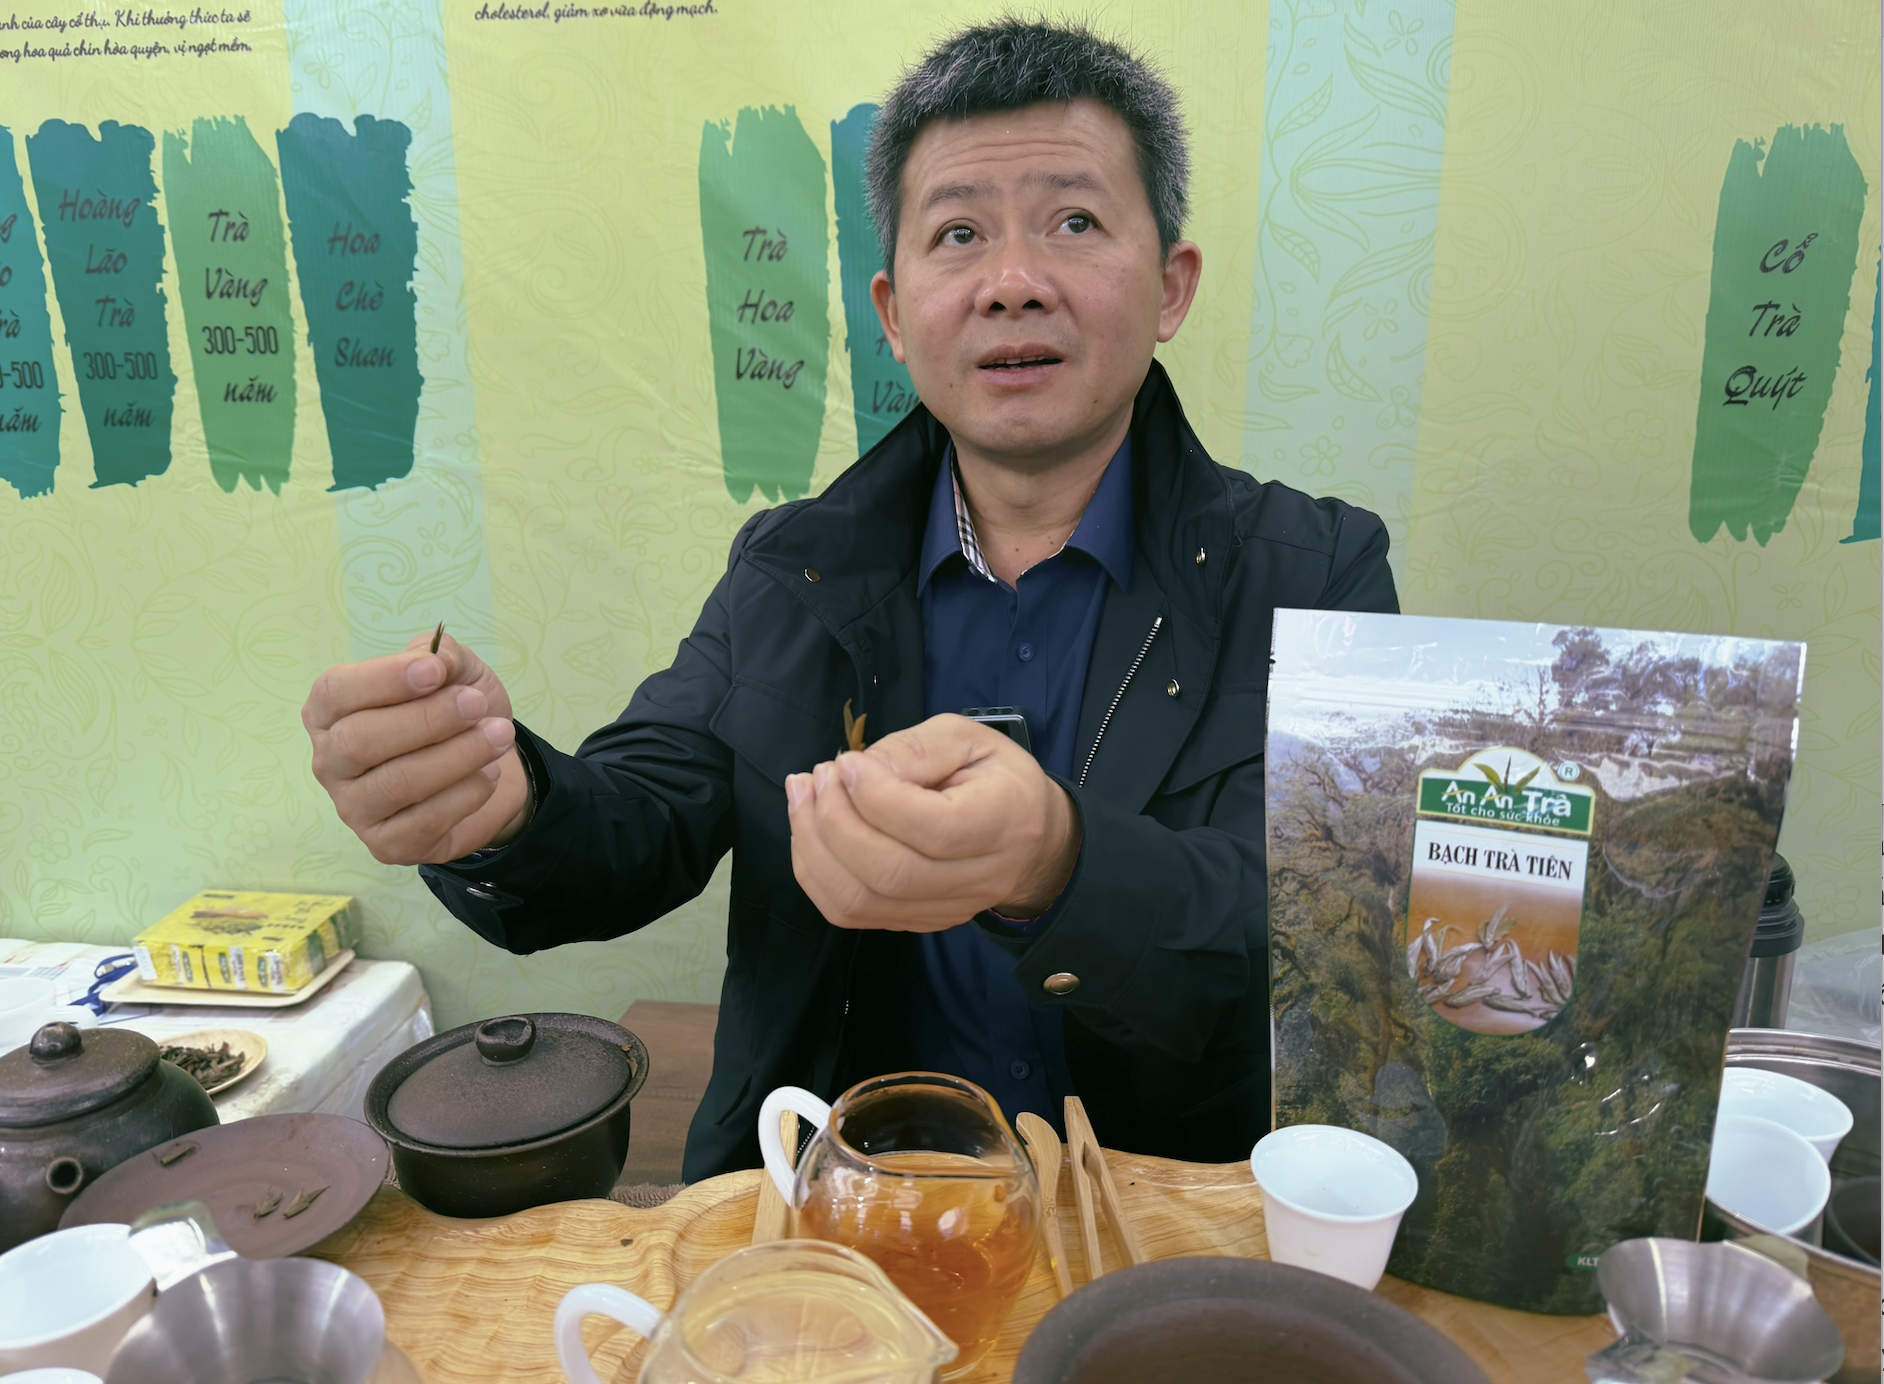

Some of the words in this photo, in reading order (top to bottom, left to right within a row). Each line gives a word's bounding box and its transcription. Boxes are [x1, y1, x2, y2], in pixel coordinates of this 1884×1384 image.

[21, 16, 43, 30] của
[45, 16, 67, 33] cây
[68, 12, 84, 28] cổ
[115, 9, 141, 27] Khi
[220, 8, 236, 24] ta
[236, 9, 251, 23] sẽ
[553, 3, 590, 24] giảm
[639, 0, 674, 21] động
[676, 0, 718, 18] mạch.
[23, 41, 47, 58] hoa
[48, 42, 72, 61] quả
[73, 38, 102, 57] chín
[104, 38, 128, 55] hòa
[173, 40, 187, 57] vị
[188, 38, 217, 58] ngọt
[58, 188, 141, 229] Hoàng
[208, 208, 250, 243] Trà
[328, 222, 381, 257] Hoa
[742, 226, 788, 263] Trà
[1759, 232, 1818, 275] Cổ
[85, 244, 128, 275] Lão
[204, 267, 268, 308] Vàng
[336, 281, 385, 312] Chè
[95, 294, 136, 329] Trà
[737, 288, 795, 324] Hoa
[1749, 300, 1801, 338] Trà
[202, 326, 279, 356] 300-500
[334, 337, 396, 368] Shan
[83, 352, 158, 381] 300-500
[735, 348, 804, 390] Vàng
[223, 376, 278, 404] năm
[1722, 365, 1808, 411] Quýt
[103, 402, 155, 428] năm
[1441, 780, 1476, 805] An
[1479, 785, 1514, 809] An
[1521, 790, 1572, 817] Trà
[1446, 802, 1466, 815] Tốt
[1471, 805, 1496, 818] cho
[1499, 809, 1523, 822] sức
[1525, 811, 1560, 826] khỏe
[1428, 842, 1478, 866] BẠCH
[1483, 849, 1521, 873] TRÀ
[1526, 855, 1573, 881] TIÊN
